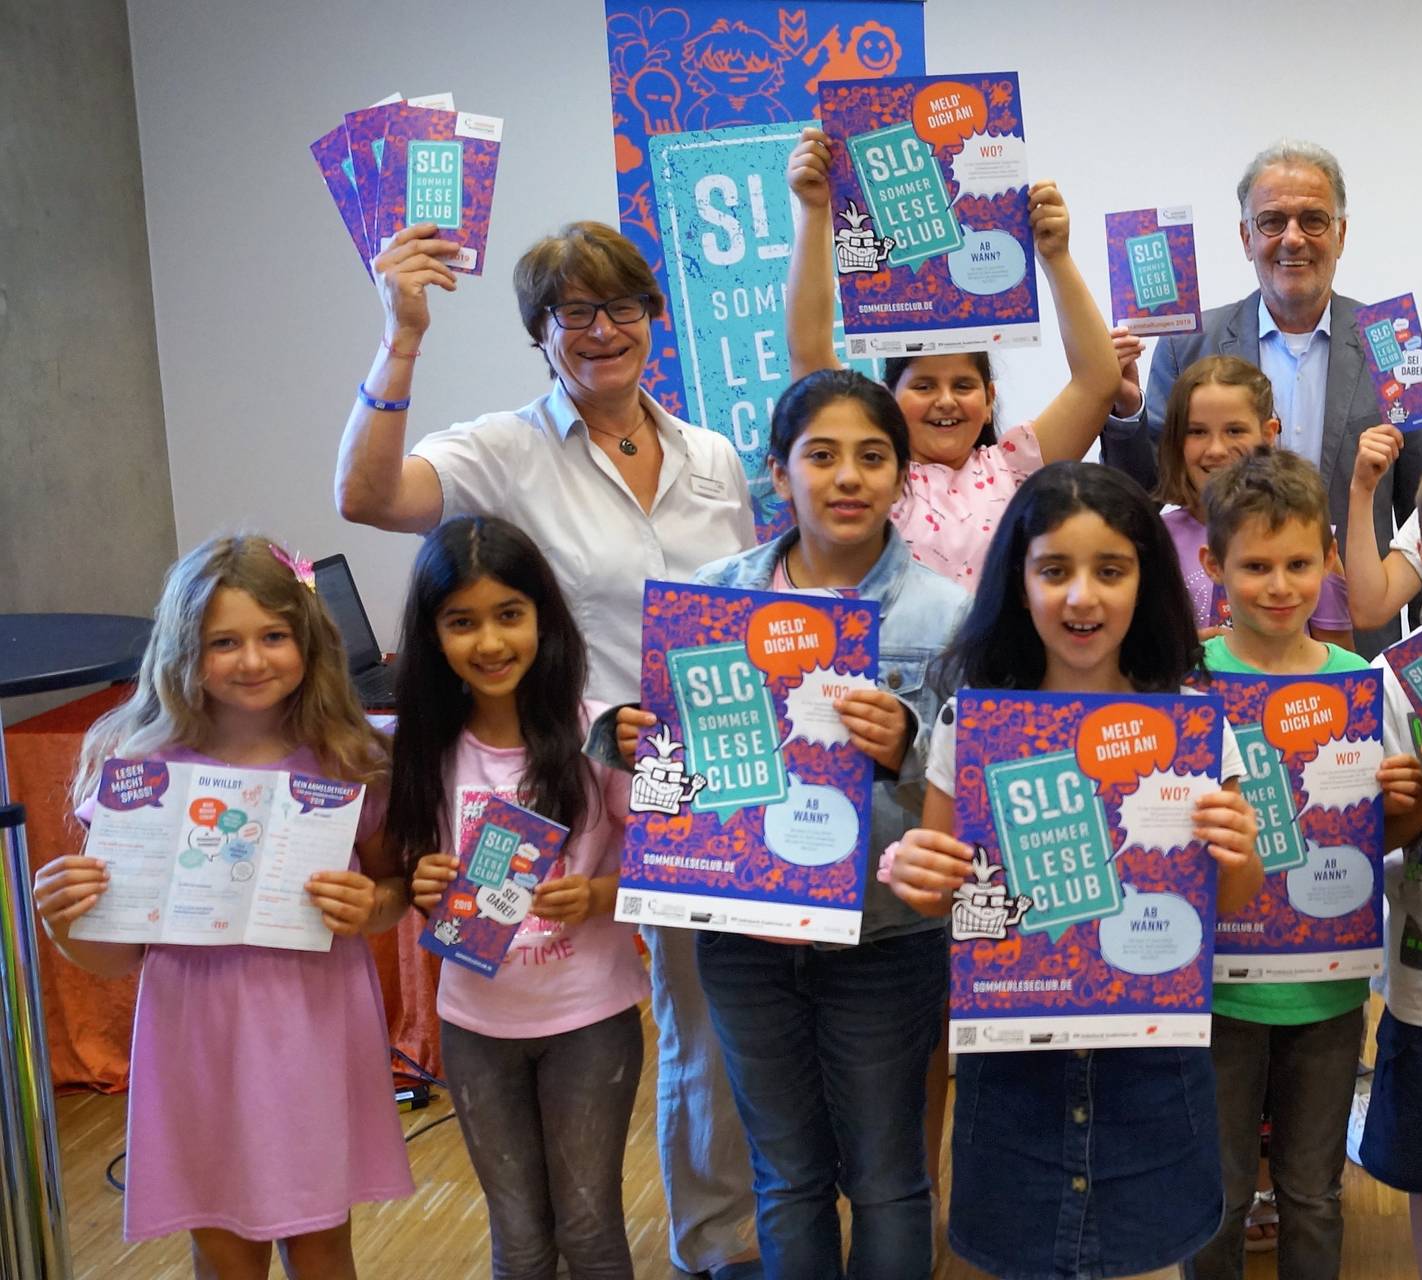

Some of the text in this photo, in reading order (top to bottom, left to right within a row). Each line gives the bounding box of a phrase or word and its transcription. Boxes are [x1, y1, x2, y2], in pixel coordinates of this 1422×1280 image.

[929, 93, 961, 112] MELD'
[927, 105, 974, 128] DICH AN!
[866, 138, 925, 182] SLC
[980, 145, 1003, 157] WO?
[416, 150, 453, 173] SLC
[417, 188, 452, 202] LESE
[879, 178, 932, 202] SOMMER
[416, 204, 452, 218] CLUB
[695, 173, 802, 266] SL
[884, 193, 939, 227] LESE
[893, 219, 946, 249] CLUB
[980, 242, 990, 251] AB
[1134, 241, 1163, 263] SLC
[971, 252, 1001, 262] WANN?
[1140, 271, 1167, 286] LESE
[1143, 284, 1170, 299] CLUB
[1370, 325, 1391, 342] SLC
[1408, 356, 1419, 364] SEI
[768, 618, 807, 636] MELD'
[763, 634, 819, 655] DICH AN!
[687, 661, 755, 707] SLC
[1284, 696, 1321, 715] MELD'
[698, 712, 760, 731] SOMMER
[1101, 719, 1144, 741] MELD'
[1279, 709, 1333, 733] DICH AN!
[703, 733, 765, 761] LESE
[1095, 737, 1158, 761] DICH AN!
[1336, 752, 1361, 765] WO?
[706, 763, 769, 792] CLUB
[1007, 770, 1085, 825] SLC
[1160, 787, 1191, 801] WO?
[805, 799, 819, 810] AB
[793, 810, 829, 826] WANN?
[484, 831, 513, 853] SLC
[1019, 822, 1089, 849] SOMMER
[1256, 831, 1288, 858] UB
[643, 853, 736, 873] SOMMERLESECLUB.DE
[1024, 842, 1096, 882] LESE
[1324, 859, 1337, 869] AB
[1314, 870, 1347, 881] WANN?
[503, 889, 520, 903] SEI
[1031, 874, 1102, 912] CLUB
[486, 893, 517, 919] DABEI!
[1143, 907, 1158, 919] AB
[1130, 919, 1170, 933] WANN?
[517, 937, 575, 965] TIME
[973, 979, 1073, 993] SOMMERLESECLUB.DE
